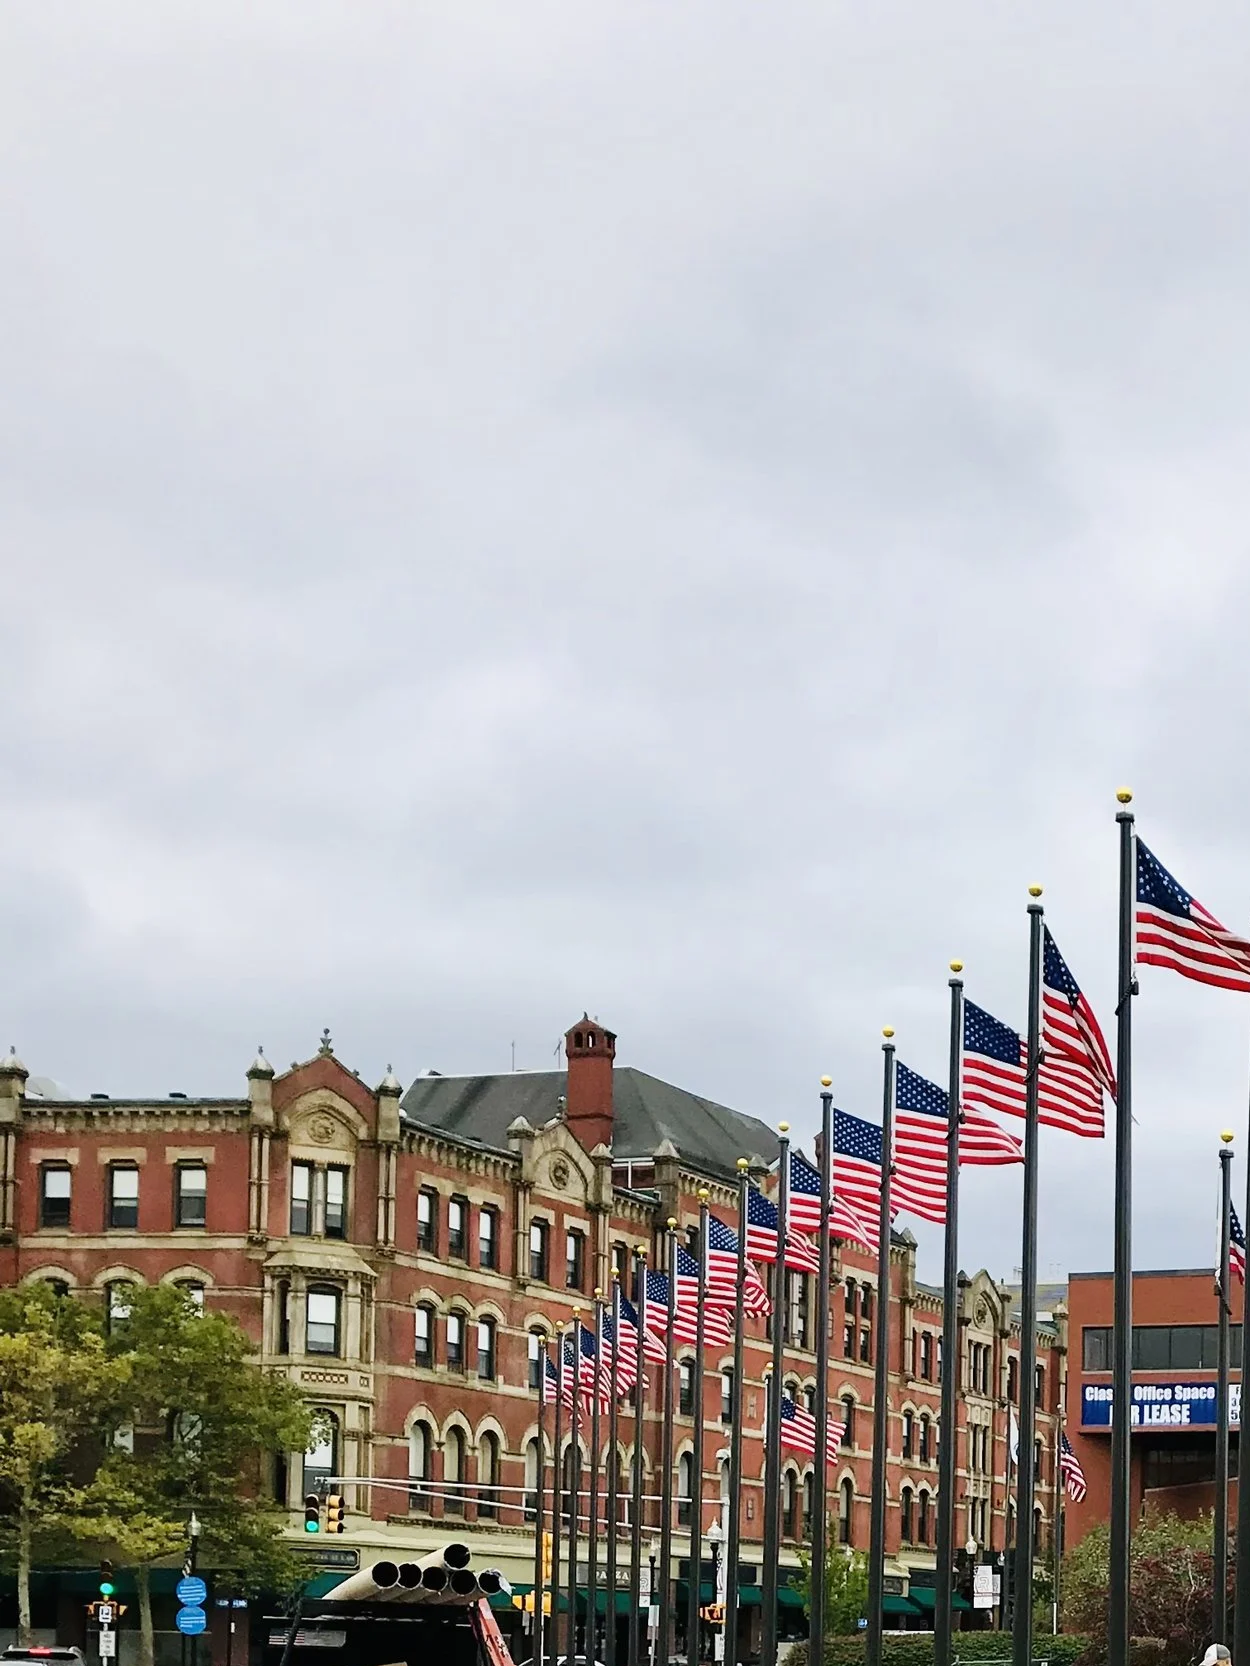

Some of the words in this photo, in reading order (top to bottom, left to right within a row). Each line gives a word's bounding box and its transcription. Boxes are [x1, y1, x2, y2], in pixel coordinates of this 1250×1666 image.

[1133, 1385, 1172, 1401] Office
[1174, 1385, 1216, 1402] Space
[1144, 1404, 1191, 1425] LEASE
